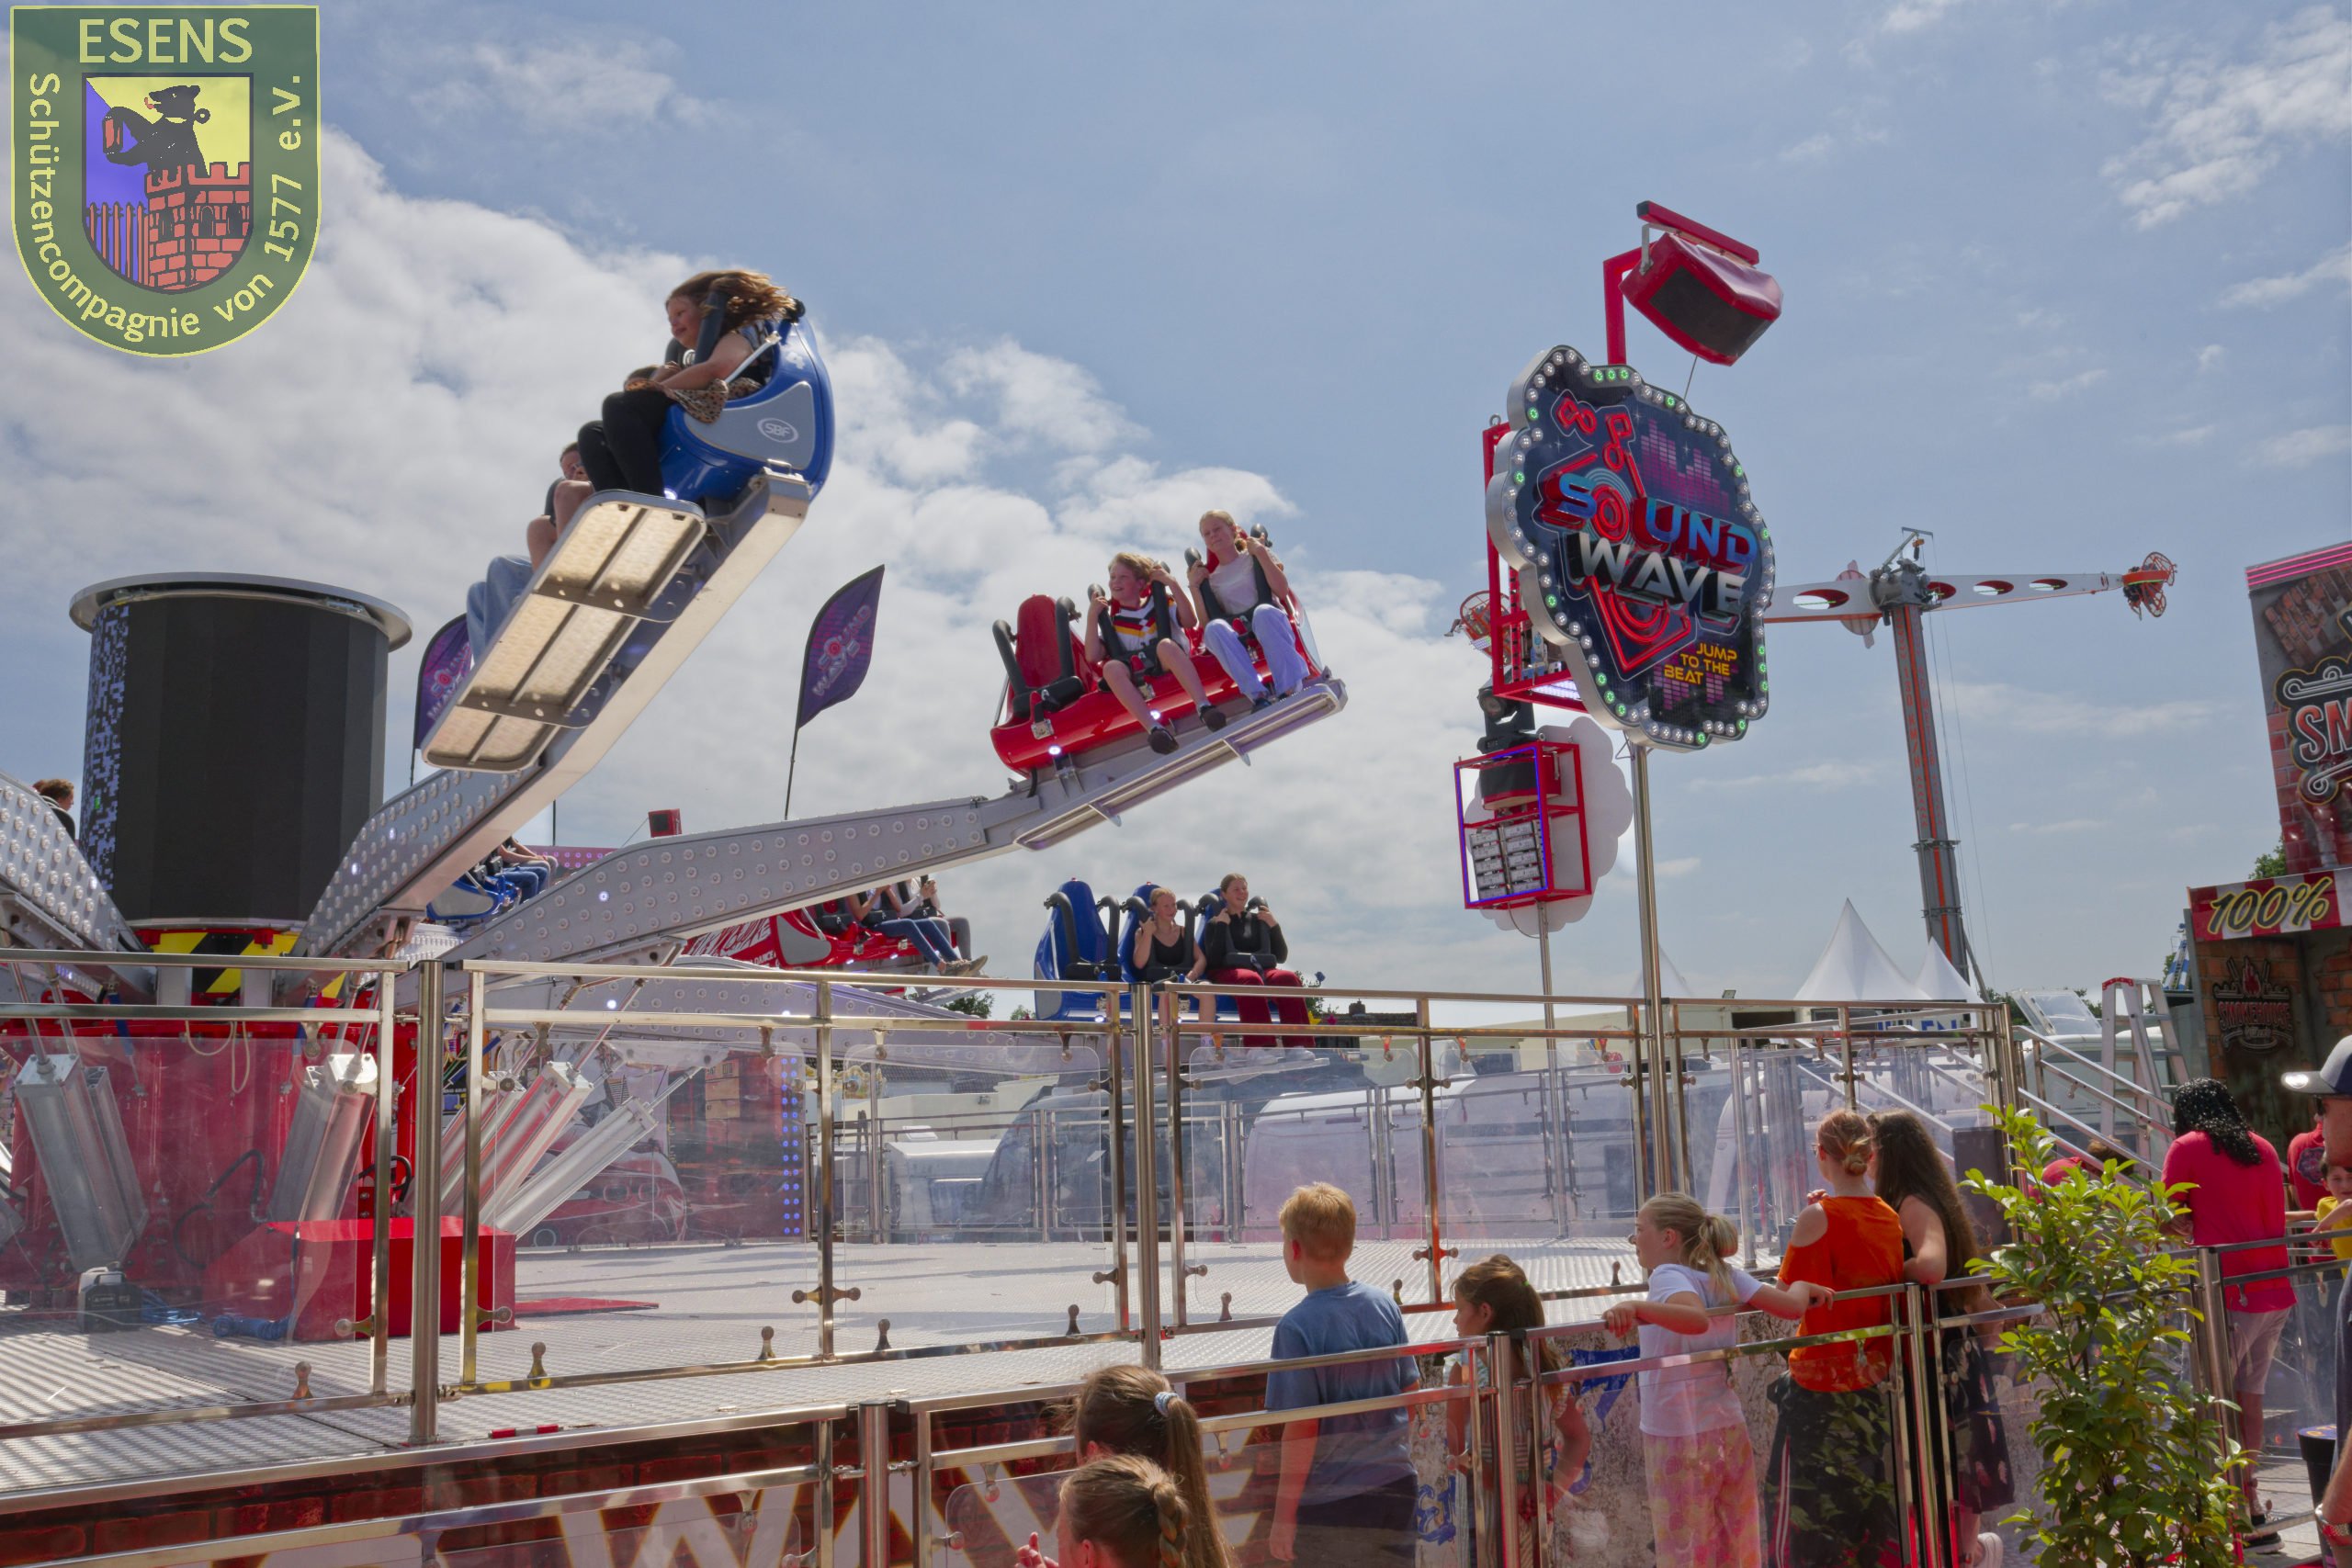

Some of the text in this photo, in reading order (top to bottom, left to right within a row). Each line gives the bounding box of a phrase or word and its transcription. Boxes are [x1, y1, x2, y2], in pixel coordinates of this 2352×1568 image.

[765, 423, 790, 437] SBF
[1549, 472, 1758, 566] SOUND
[1572, 532, 1747, 617] WAVE
[817, 604, 872, 671] SOUND
[1679, 653, 1731, 676] TO THE
[1696, 642, 1737, 661] JUMP
[812, 638, 861, 697] WAVE
[1664, 663, 1704, 685] BEAT
[2208, 876, 2333, 935] 100%
